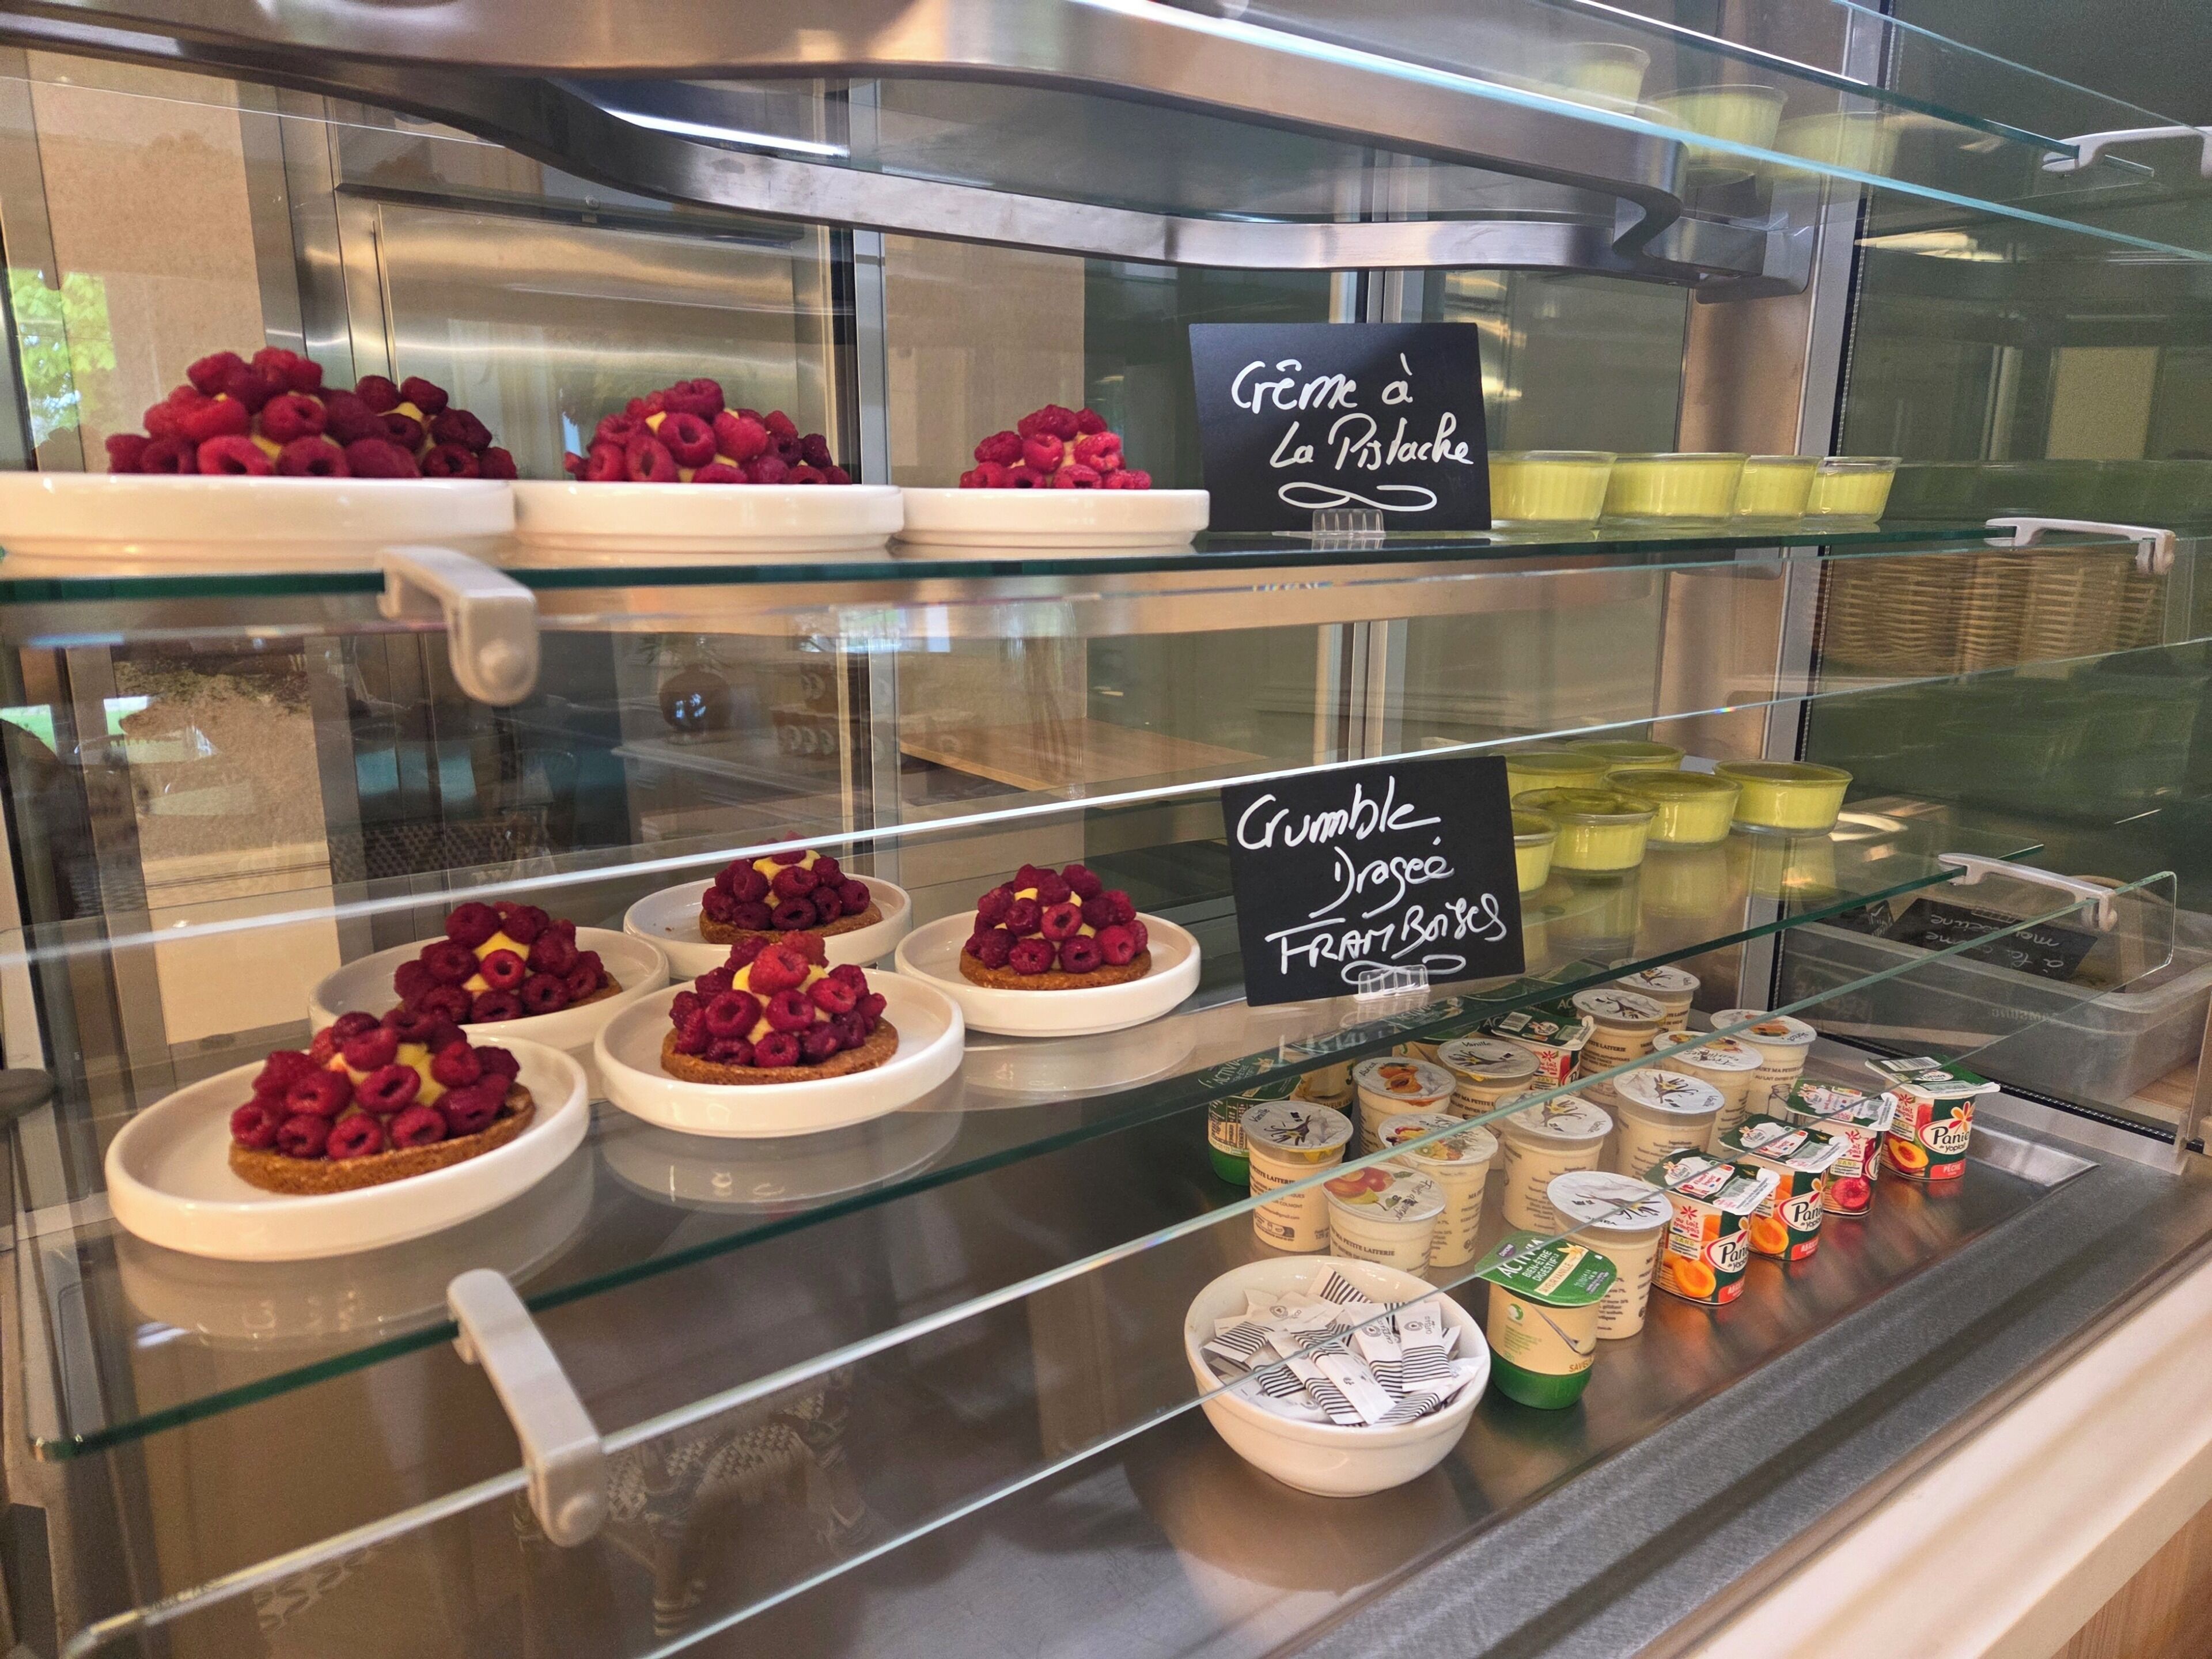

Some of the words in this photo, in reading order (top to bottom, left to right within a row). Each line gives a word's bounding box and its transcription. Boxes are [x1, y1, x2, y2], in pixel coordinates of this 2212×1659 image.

[1382, 353, 1413, 404] à
[1328, 411, 1474, 471] Pistache
[1237, 775, 1441, 850] Crumble
[1343, 1237, 1363, 1251] PETITE
[1363, 1247, 1396, 1256] LAITERIE
[1521, 1249, 1552, 1278] BIEN-ÊTRE
